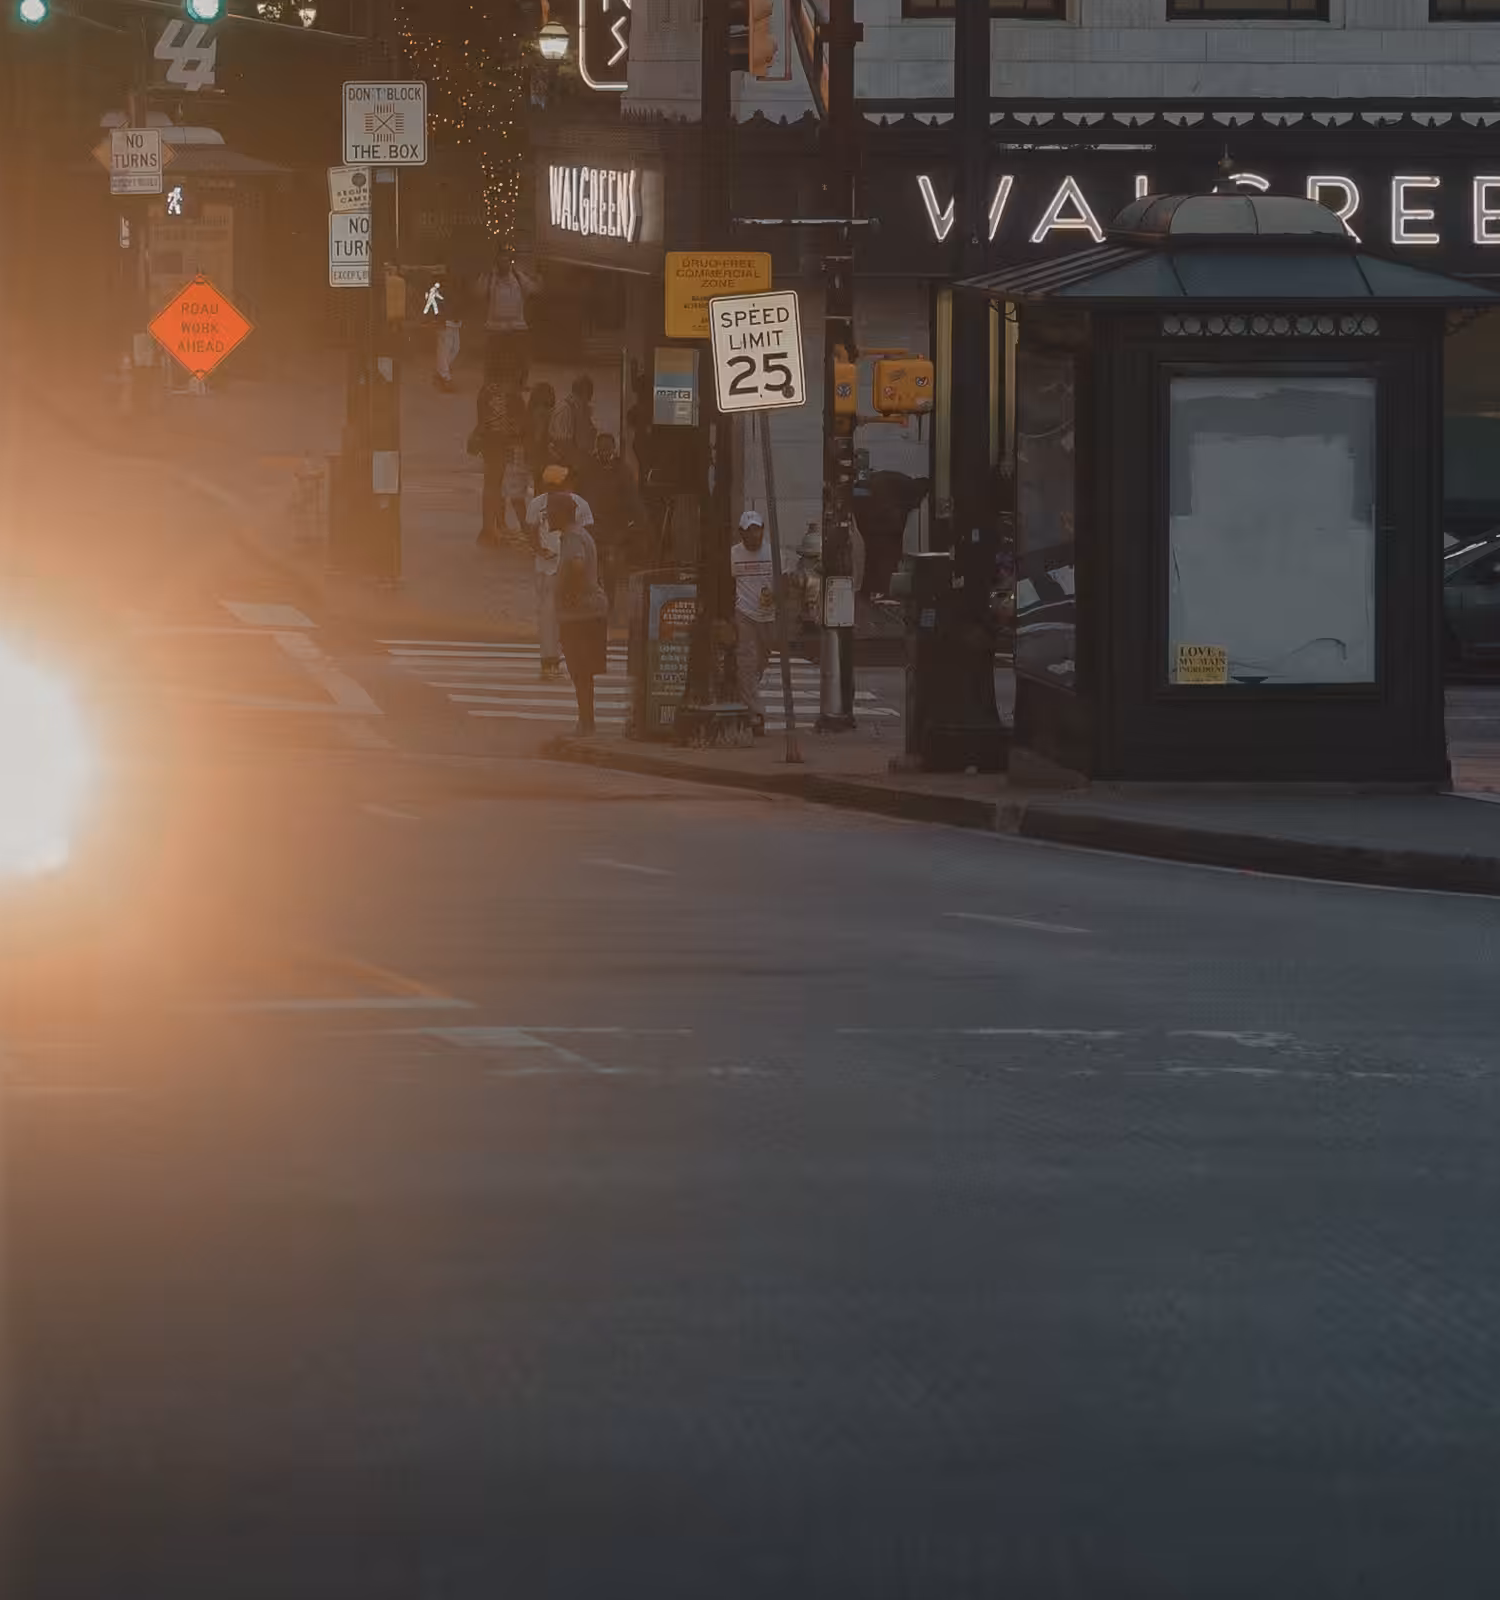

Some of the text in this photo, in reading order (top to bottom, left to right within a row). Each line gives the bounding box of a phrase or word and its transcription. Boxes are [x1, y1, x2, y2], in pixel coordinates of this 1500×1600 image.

[386, 87, 422, 101] BLOCK
[126, 134, 144, 149] NO
[352, 144, 419, 159] THE BOX
[114, 152, 158, 169] TURNS
[549, 164, 637, 243] WALGREENS
[349, 218, 370, 234] NO
[334, 240, 373, 257] TURN
[675, 268, 762, 279] COMMERCIAL
[700, 279, 736, 288] ZONE
[181, 302, 219, 315] ROAD
[720, 307, 790, 328] SPEED
[180, 322, 219, 334] WORK
[178, 340, 225, 353] AHEAD
[729, 330, 784, 350] LIMIT
[726, 352, 793, 396] 25
[656, 389, 691, 399] marta
